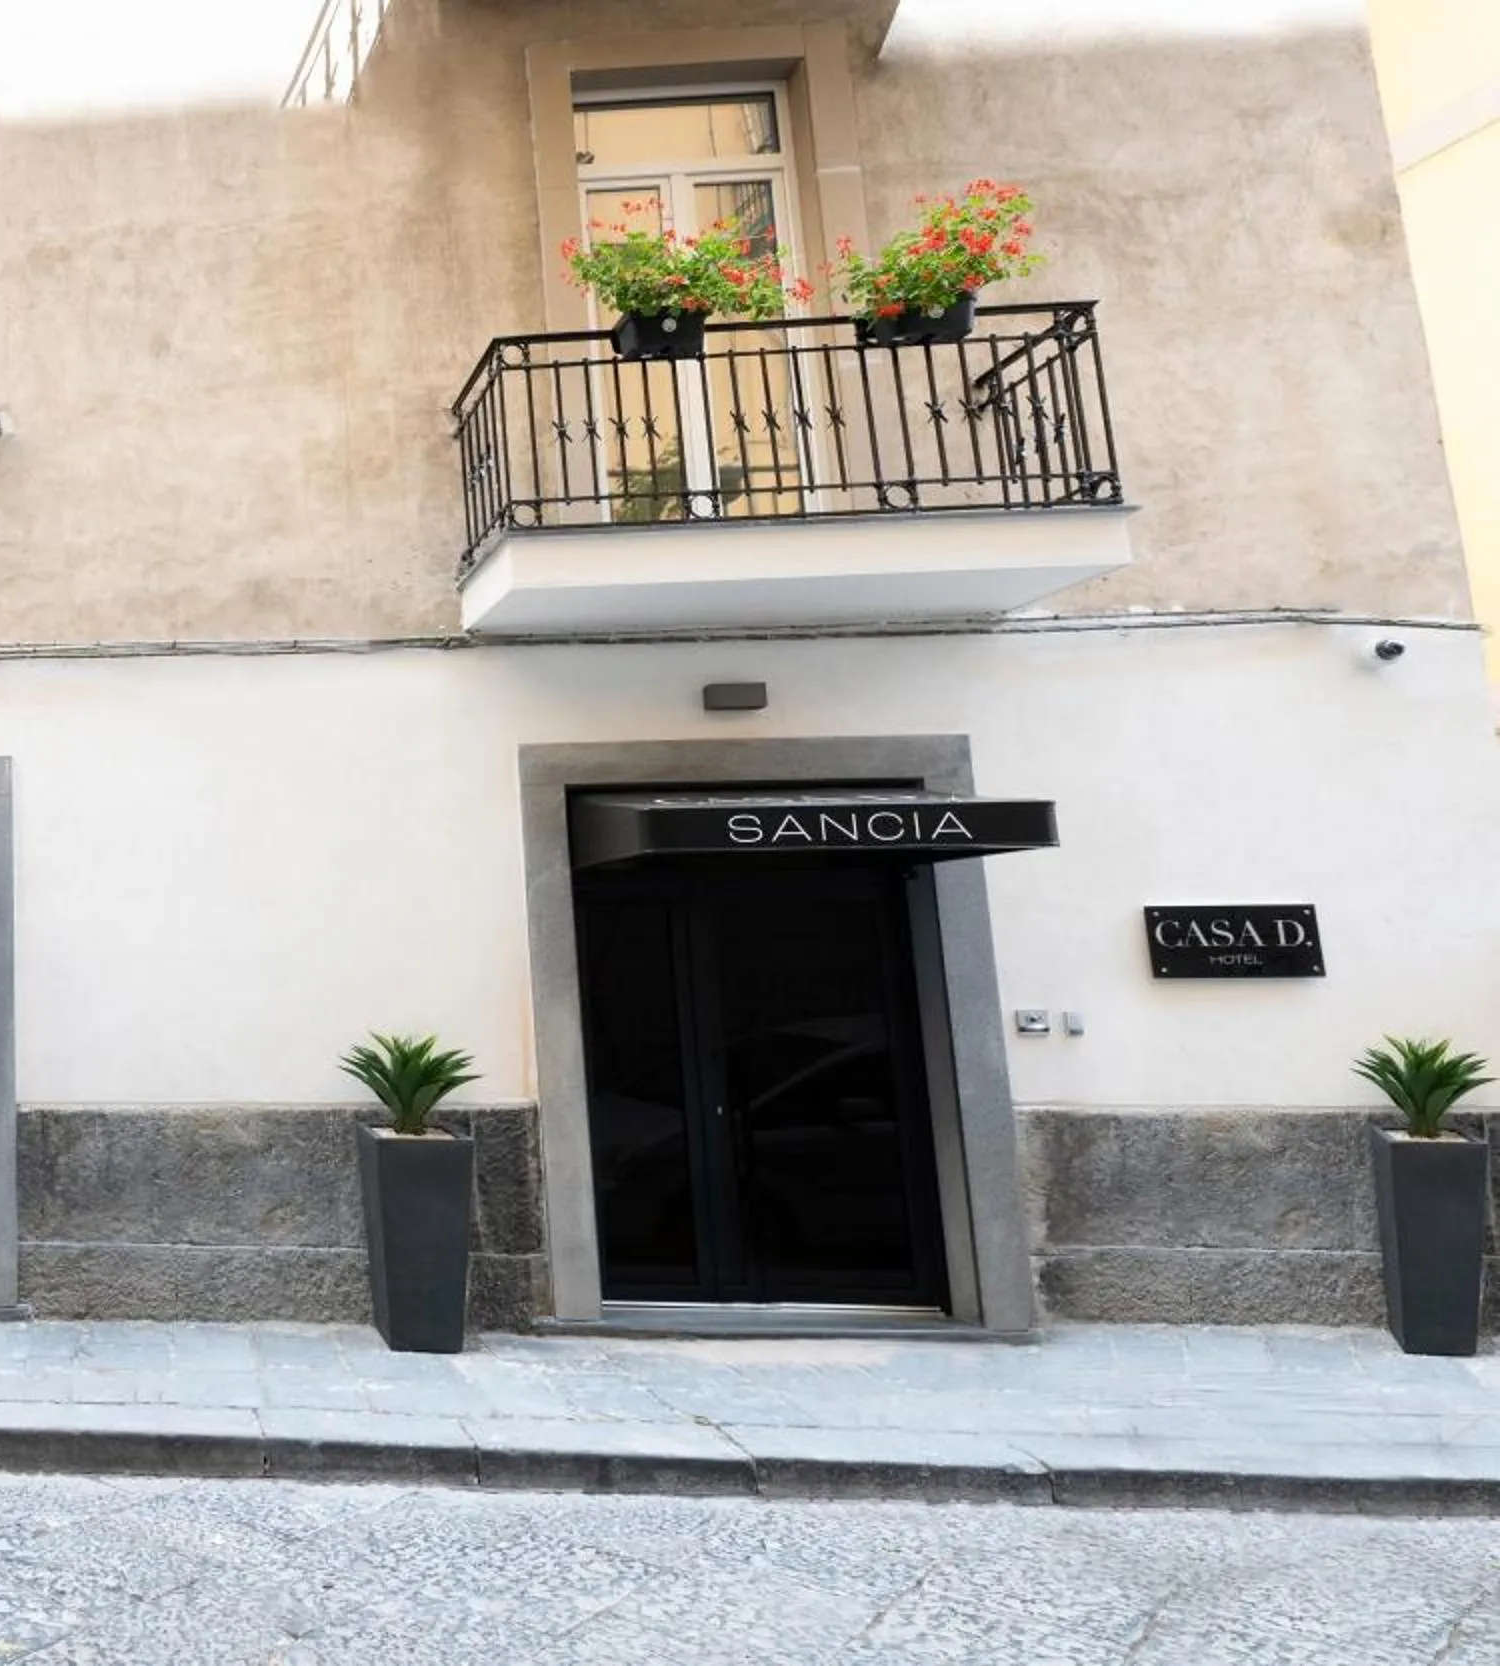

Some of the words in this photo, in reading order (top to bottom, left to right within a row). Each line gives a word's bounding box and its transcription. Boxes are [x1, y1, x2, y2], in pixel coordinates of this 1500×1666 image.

[727, 811, 974, 843] SANCIA
[1154, 919, 1268, 948] CASA
[1272, 919, 1314, 948] D.
[1208, 953, 1264, 966] HOTEL
